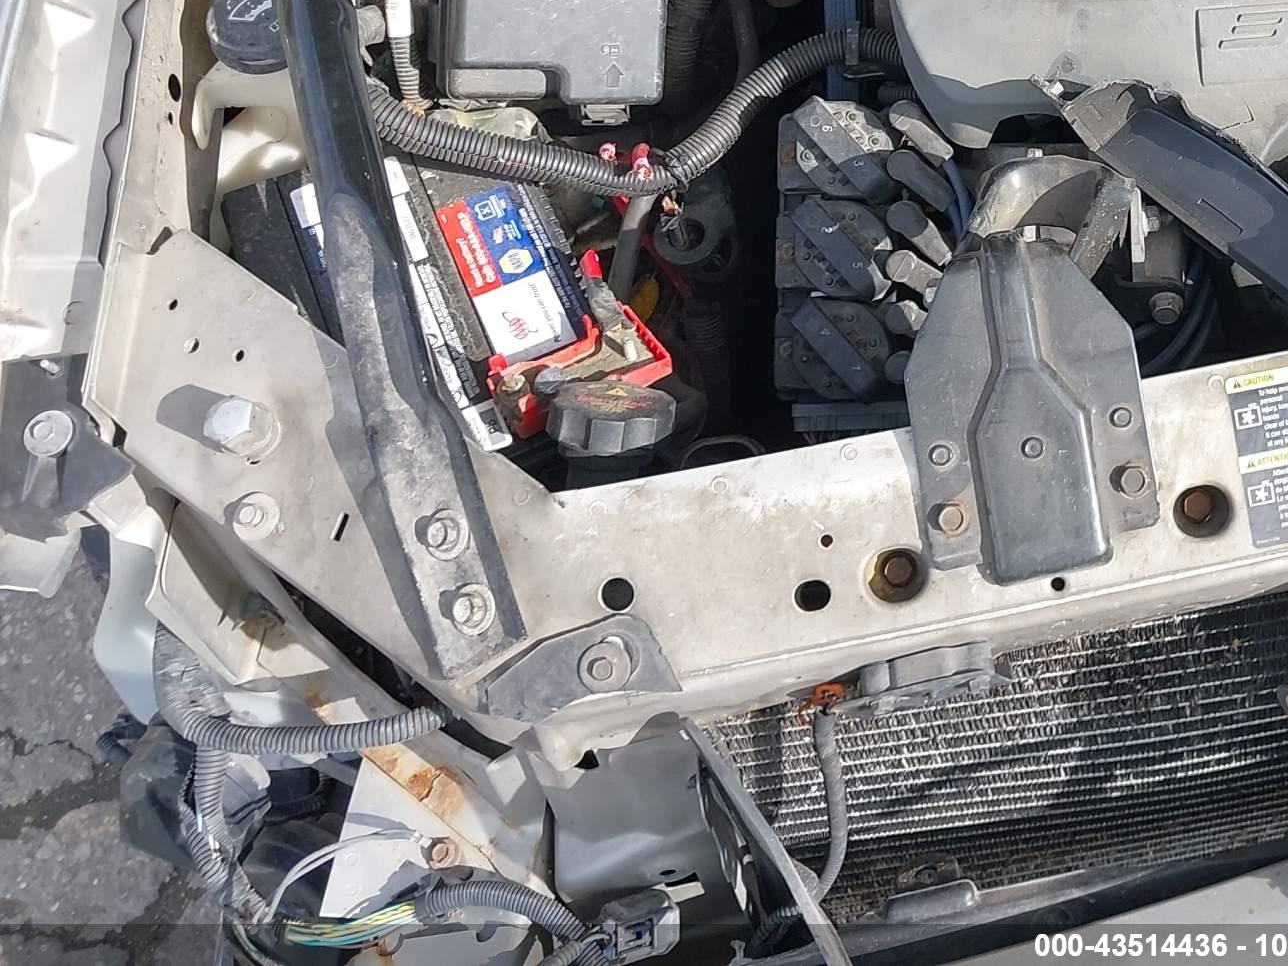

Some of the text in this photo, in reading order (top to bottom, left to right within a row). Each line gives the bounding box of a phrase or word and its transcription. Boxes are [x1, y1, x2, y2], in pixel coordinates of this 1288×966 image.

[506, 251, 524, 270] NAPA
[528, 282, 541, 297] trust
[535, 298, 546, 309] can
[540, 309, 553, 322] you
[506, 315, 531, 340] AAA
[1242, 374, 1273, 386] CAUTION
